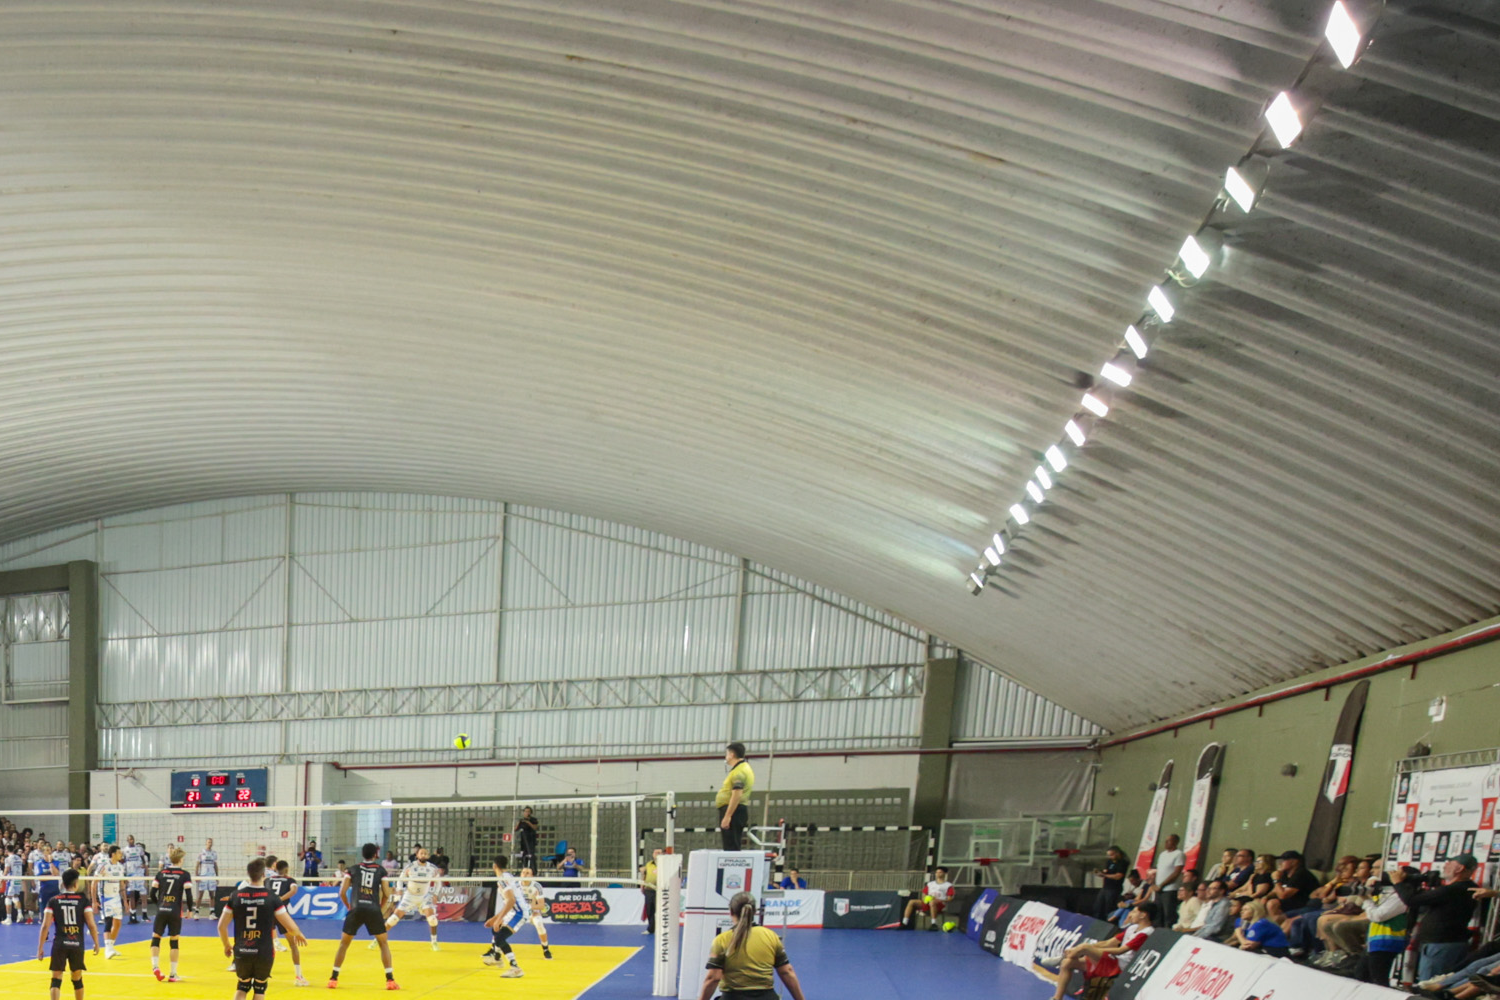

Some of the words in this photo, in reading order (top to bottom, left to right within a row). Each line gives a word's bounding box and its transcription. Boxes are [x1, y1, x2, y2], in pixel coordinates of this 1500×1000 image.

[187, 791, 200, 802] 21
[238, 790, 251, 800] 22
[360, 870, 374, 888] 18
[166, 879, 175, 895] 7
[271, 881, 282, 895] 9
[764, 899, 802, 908] RANDE
[61, 905, 77, 925] 10
[245, 906, 258, 929] 2
[243, 930, 261, 940] HJR
